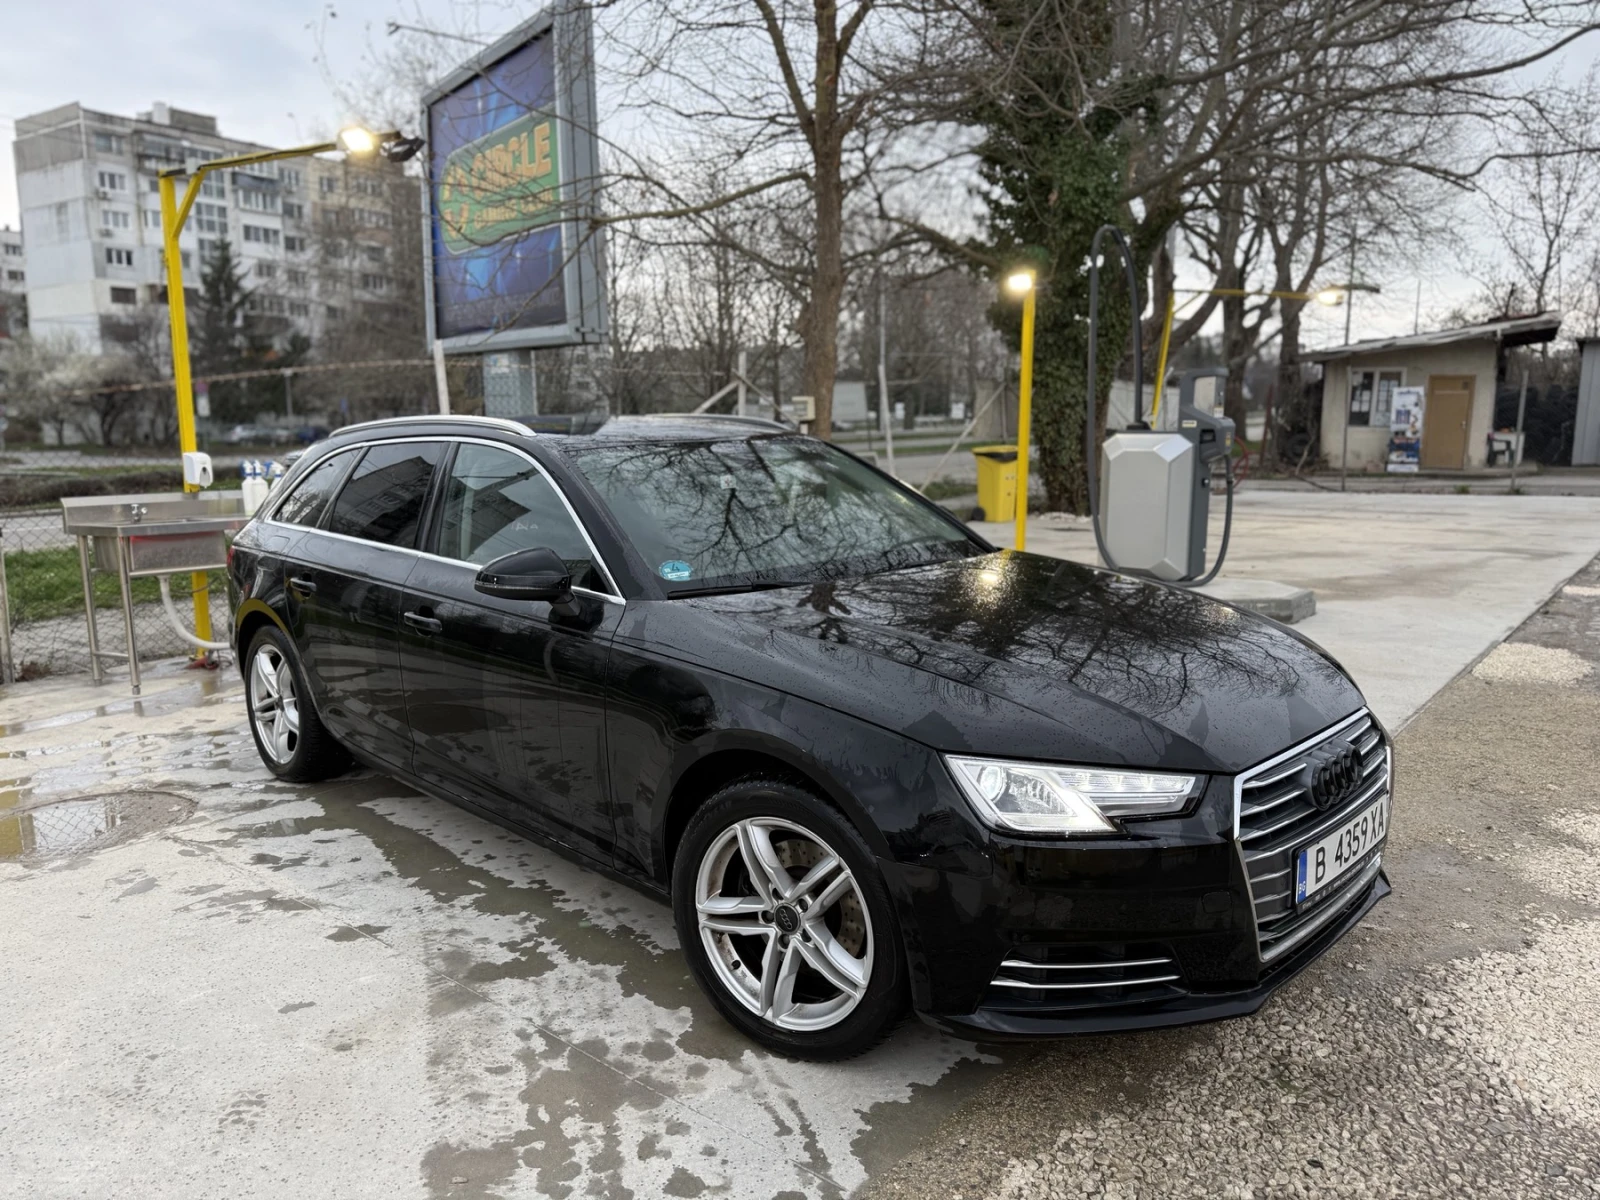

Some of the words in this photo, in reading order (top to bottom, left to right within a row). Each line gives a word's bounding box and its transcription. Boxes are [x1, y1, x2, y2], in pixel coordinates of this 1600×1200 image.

[671, 563, 680, 572] 4
[1315, 846, 1326, 885] B
[1334, 816, 1368, 868] 4359
[1370, 802, 1384, 844] XA
